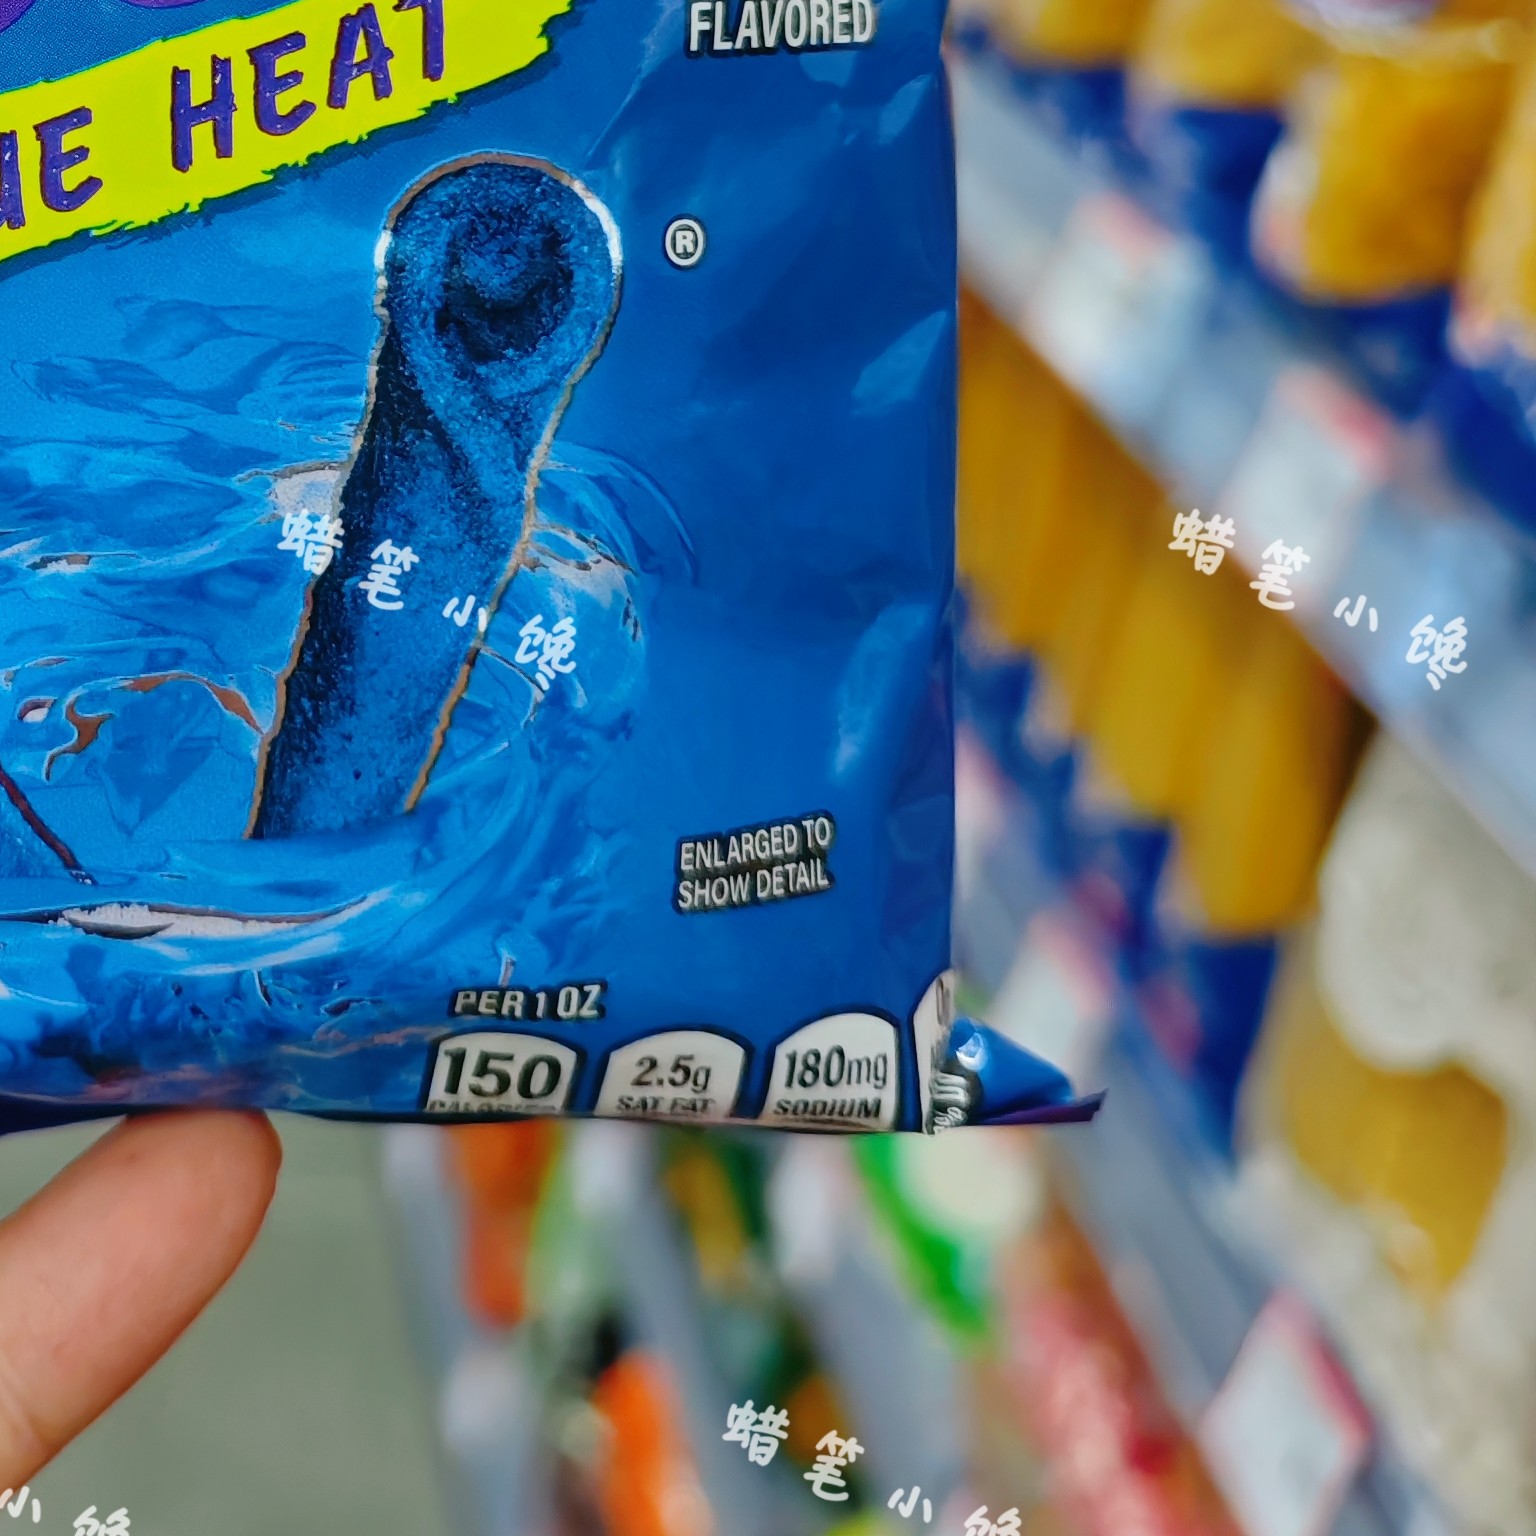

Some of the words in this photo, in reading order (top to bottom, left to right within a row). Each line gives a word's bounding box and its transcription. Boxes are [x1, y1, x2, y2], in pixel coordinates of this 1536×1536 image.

[680, 823, 798, 872] ENLARGED
[802, 816, 831, 849] TO
[677, 872, 751, 909] SHOW
[756, 857, 830, 899] DETAIL
[454, 989, 524, 1018] PER
[535, 990, 547, 1020] 1
[556, 983, 604, 1020] OZ
[443, 1046, 562, 1100] 150
[630, 1053, 713, 1094] 2.5g
[785, 1045, 889, 1090] 180mg
